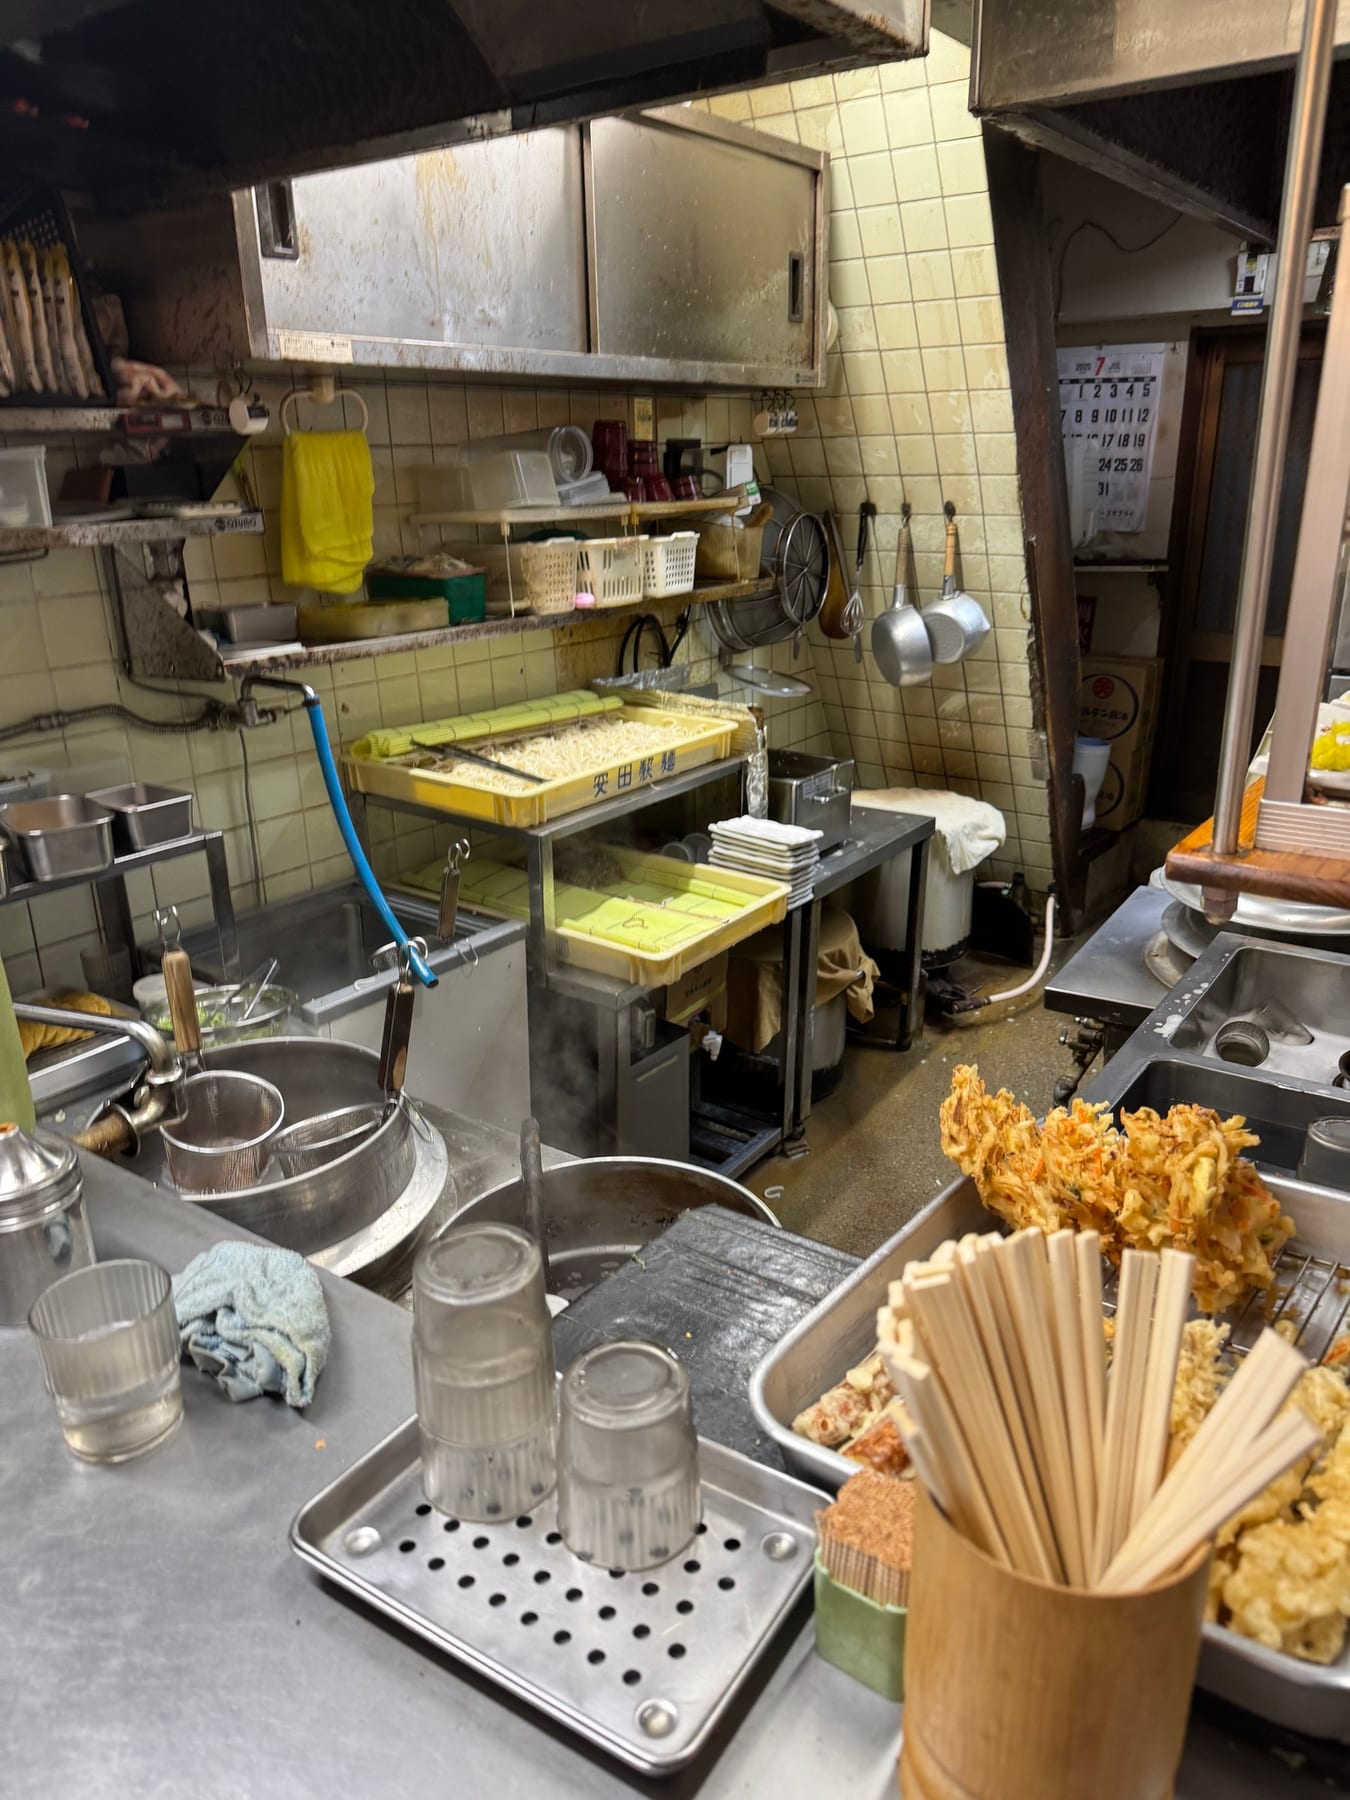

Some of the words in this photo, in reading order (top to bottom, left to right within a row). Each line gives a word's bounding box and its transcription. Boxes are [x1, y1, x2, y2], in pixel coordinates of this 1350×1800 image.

[1094, 355, 1106, 376] 7
[1079, 385, 1084, 398] 1
[1093, 384, 1101, 398] 2
[1110, 384, 1118, 398] 3
[1126, 383, 1134, 397] 4
[1142, 383, 1151, 397] 5
[1075, 409, 1083, 423] 8
[1091, 409, 1099, 423] 9
[1105, 409, 1117, 423] 10
[1121, 408, 1133, 423] 11
[1137, 408, 1149, 422] 12
[1102, 433, 1114, 448] 17
[1118, 433, 1130, 448] 18
[1133, 433, 1146, 448] 19
[1098, 458, 1112, 472] 24
[1114, 458, 1128, 472] 25
[1129, 458, 1143, 472] 26
[1098, 482, 1109, 496] 31
